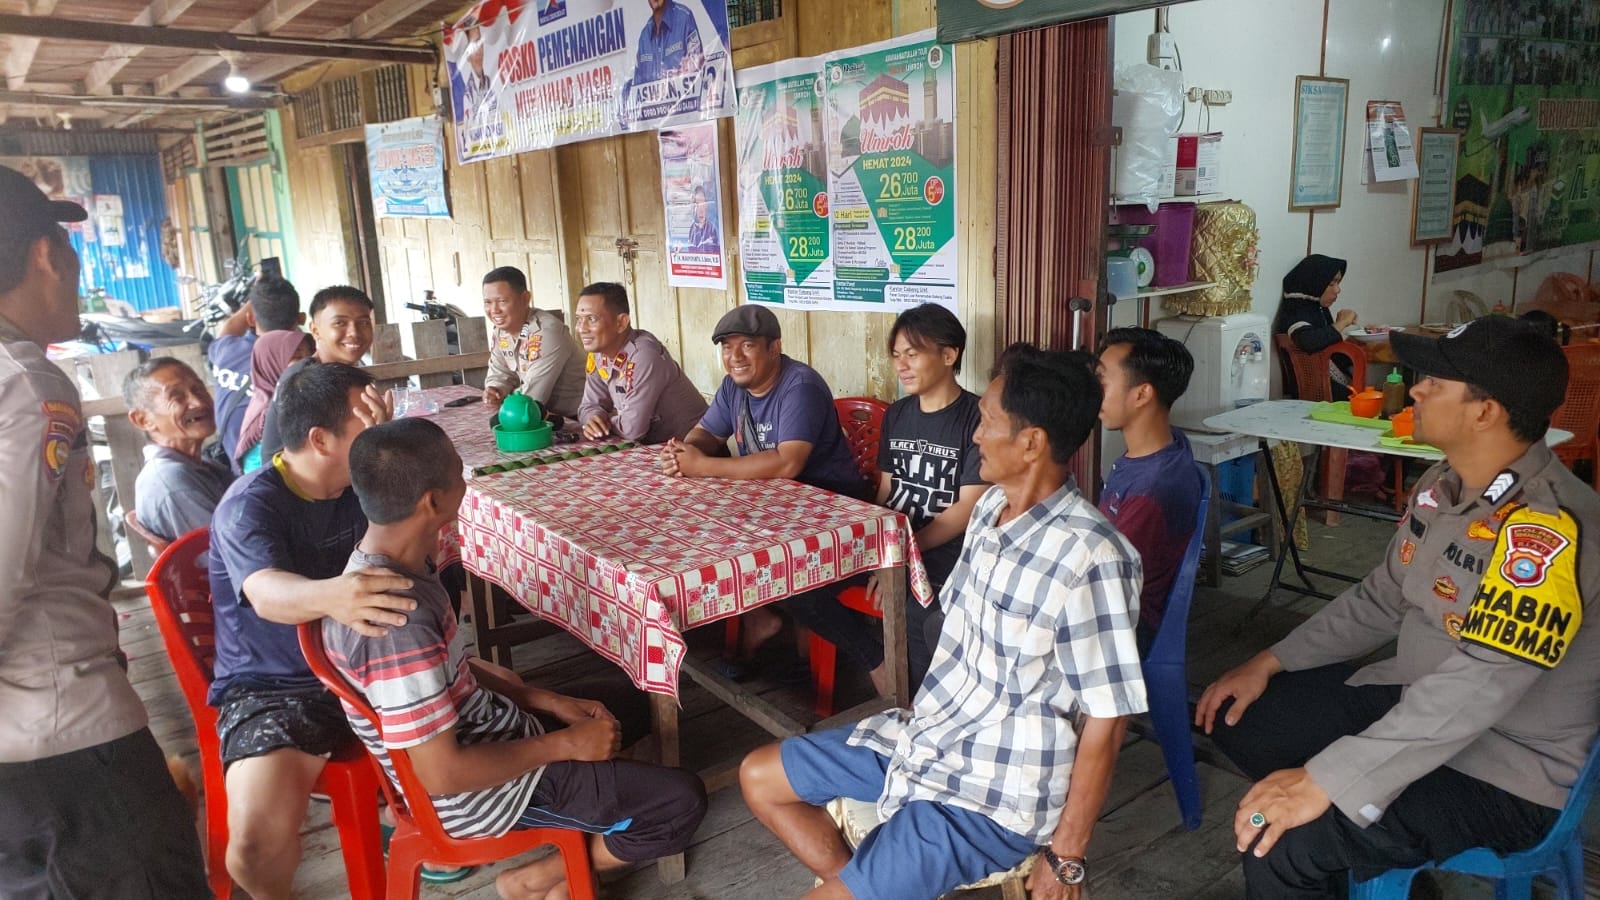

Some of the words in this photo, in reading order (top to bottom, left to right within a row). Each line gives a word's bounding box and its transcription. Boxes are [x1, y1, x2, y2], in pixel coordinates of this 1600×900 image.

[537, 8, 627, 74] PEMENANGAN
[863, 157, 888, 170] HEMAT
[890, 155, 912, 168] 2024
[879, 172, 901, 198] 26
[902, 171, 918, 184] 700
[894, 227, 916, 250] 28
[916, 226, 931, 237] 200
[789, 236, 808, 257] 28
[890, 441, 915, 450] BLACK
[928, 446, 957, 457] VIRUS
[1460, 609, 1565, 664] AMTIBMAS
